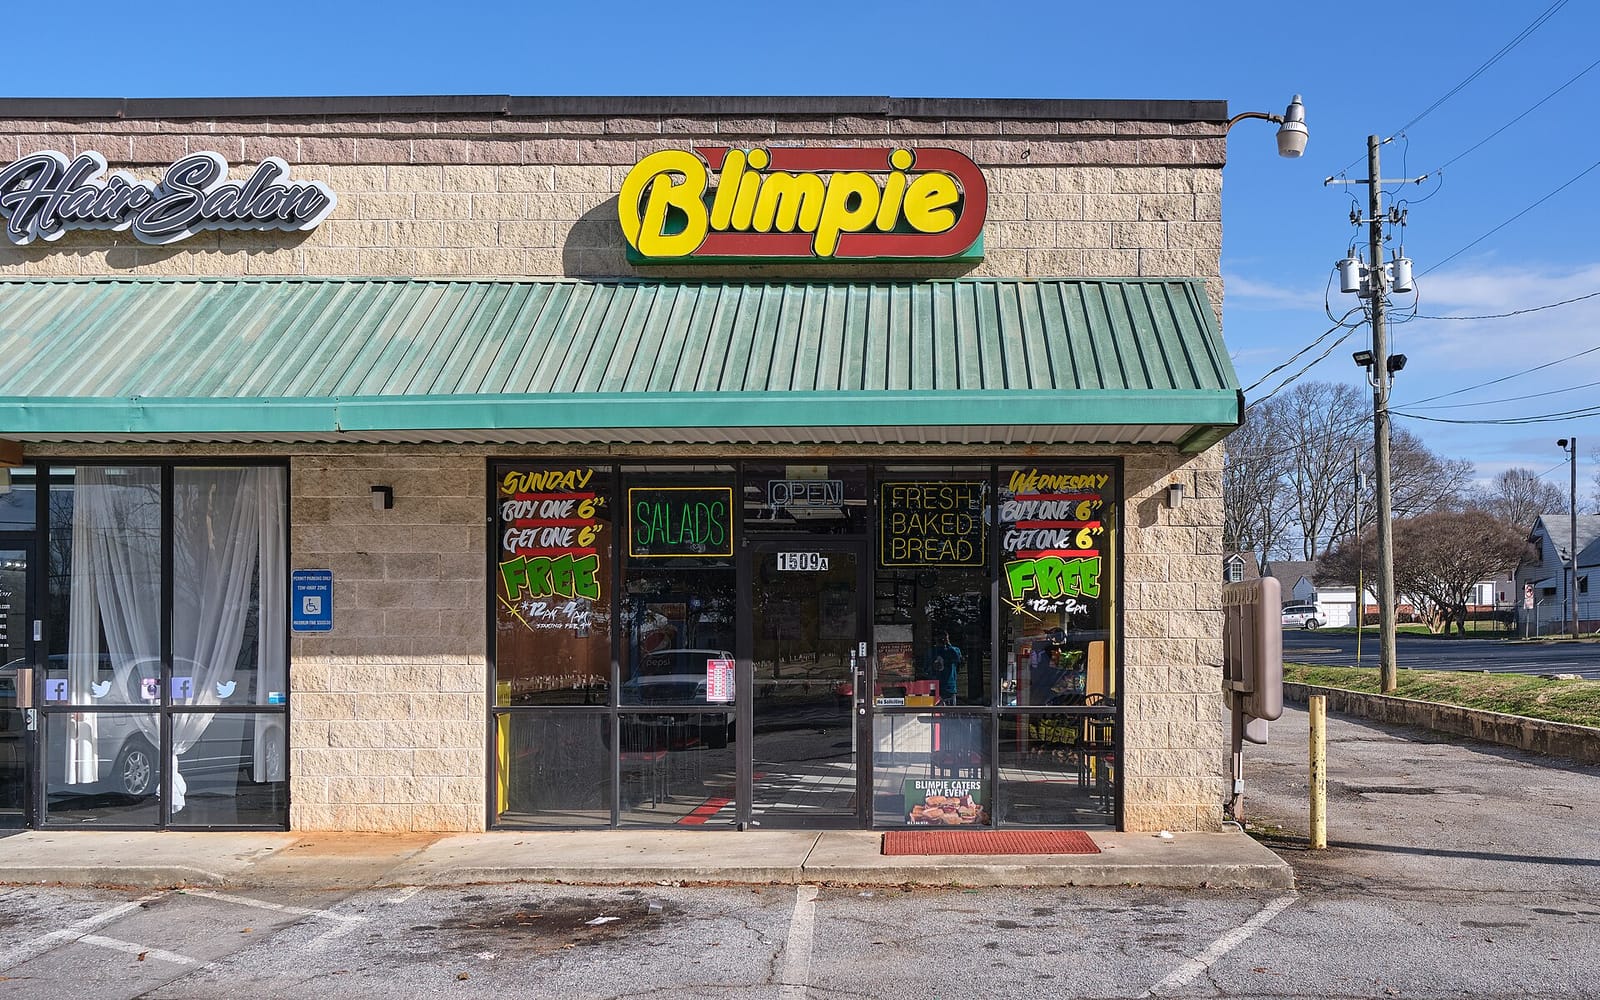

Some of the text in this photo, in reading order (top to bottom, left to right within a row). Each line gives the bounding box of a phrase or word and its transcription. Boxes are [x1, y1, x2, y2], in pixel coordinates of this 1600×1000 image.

[0, 151, 331, 238] Hair Salon
[618, 148, 960, 258] Blimpie
[501, 468, 593, 494] SUNDAY
[1008, 468, 1109, 493] WEDNESDAY
[772, 483, 840, 506] OPEN
[892, 487, 972, 510] FRESH
[502, 499, 539, 521] BUY
[540, 499, 576, 519] ONE
[1001, 500, 1038, 521] BUY
[1038, 500, 1071, 520] ONE
[637, 501, 724, 545] SALADS
[892, 513, 973, 536] BAKED
[503, 525, 541, 553] GET
[540, 524, 575, 548] ONE
[892, 537, 973, 562] BREAD
[1003, 529, 1039, 552] GET
[1036, 528, 1072, 550] ONE
[499, 552, 601, 601] FREE
[1003, 555, 1103, 600] FREE
[915, 780, 981, 790] BLIMPIE CATERS
[925, 788, 969, 797] ANY EVENT
